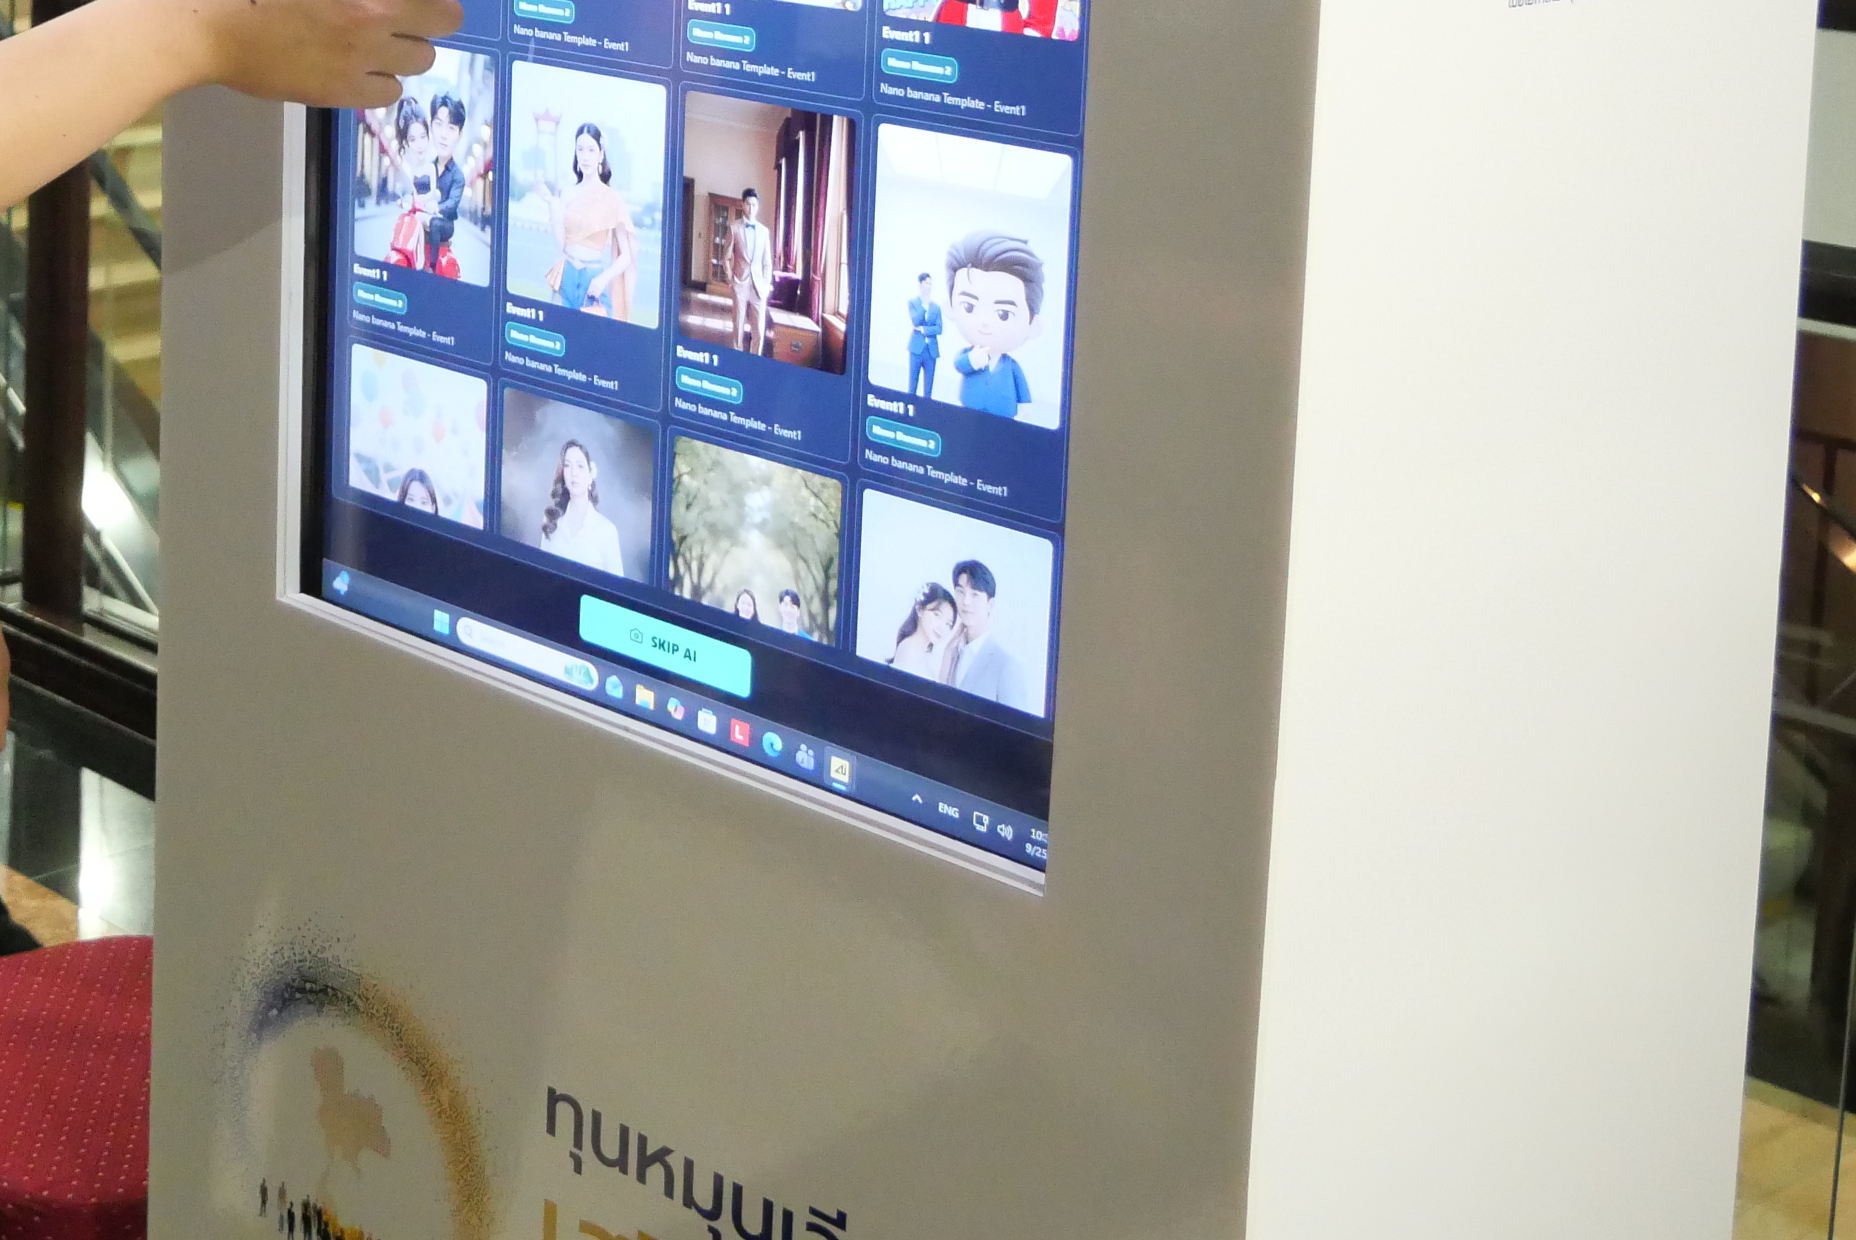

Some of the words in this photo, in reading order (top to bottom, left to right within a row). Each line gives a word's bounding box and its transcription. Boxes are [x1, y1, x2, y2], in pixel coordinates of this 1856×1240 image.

[514, 24, 532, 36] Nano
[535, 28, 561, 41] banana
[563, 32, 596, 46] Template
[604, 39, 628, 51] Event1
[883, 26, 920, 42] Event1
[687, 52, 708, 64] Nano
[710, 55, 740, 69] banana
[742, 60, 779, 76] Template
[788, 68, 815, 81] Event1
[881, 83, 904, 96] Nano
[907, 87, 941, 102] banana
[942, 93, 985, 109] Template
[994, 101, 1025, 115] Event1
[354, 264, 380, 278] Event1
[506, 302, 535, 319] Event1
[353, 310, 370, 322] Nano
[372, 315, 395, 329] banana
[397, 322, 426, 338] Template
[433, 332, 454, 345] Event1
[677, 346, 709, 363] Event1
[505, 351, 524, 364] Nano
[526, 357, 552, 372] banana
[554, 364, 587, 381] Template
[594, 375, 617, 390] Event1
[868, 394, 904, 413] Event1
[675, 397, 695, 411] Nano
[698, 404, 727, 420] banana
[729, 412, 766, 431] Template
[774, 424, 801, 440] Event1
[866, 449, 888, 464] Nano
[892, 456, 924, 474] banana
[927, 465, 967, 486] Template
[977, 479, 1007, 496] Event1
[651, 636, 680, 656] SKIP
[683, 646, 697, 663] AI
[938, 802, 959, 818] ENG
